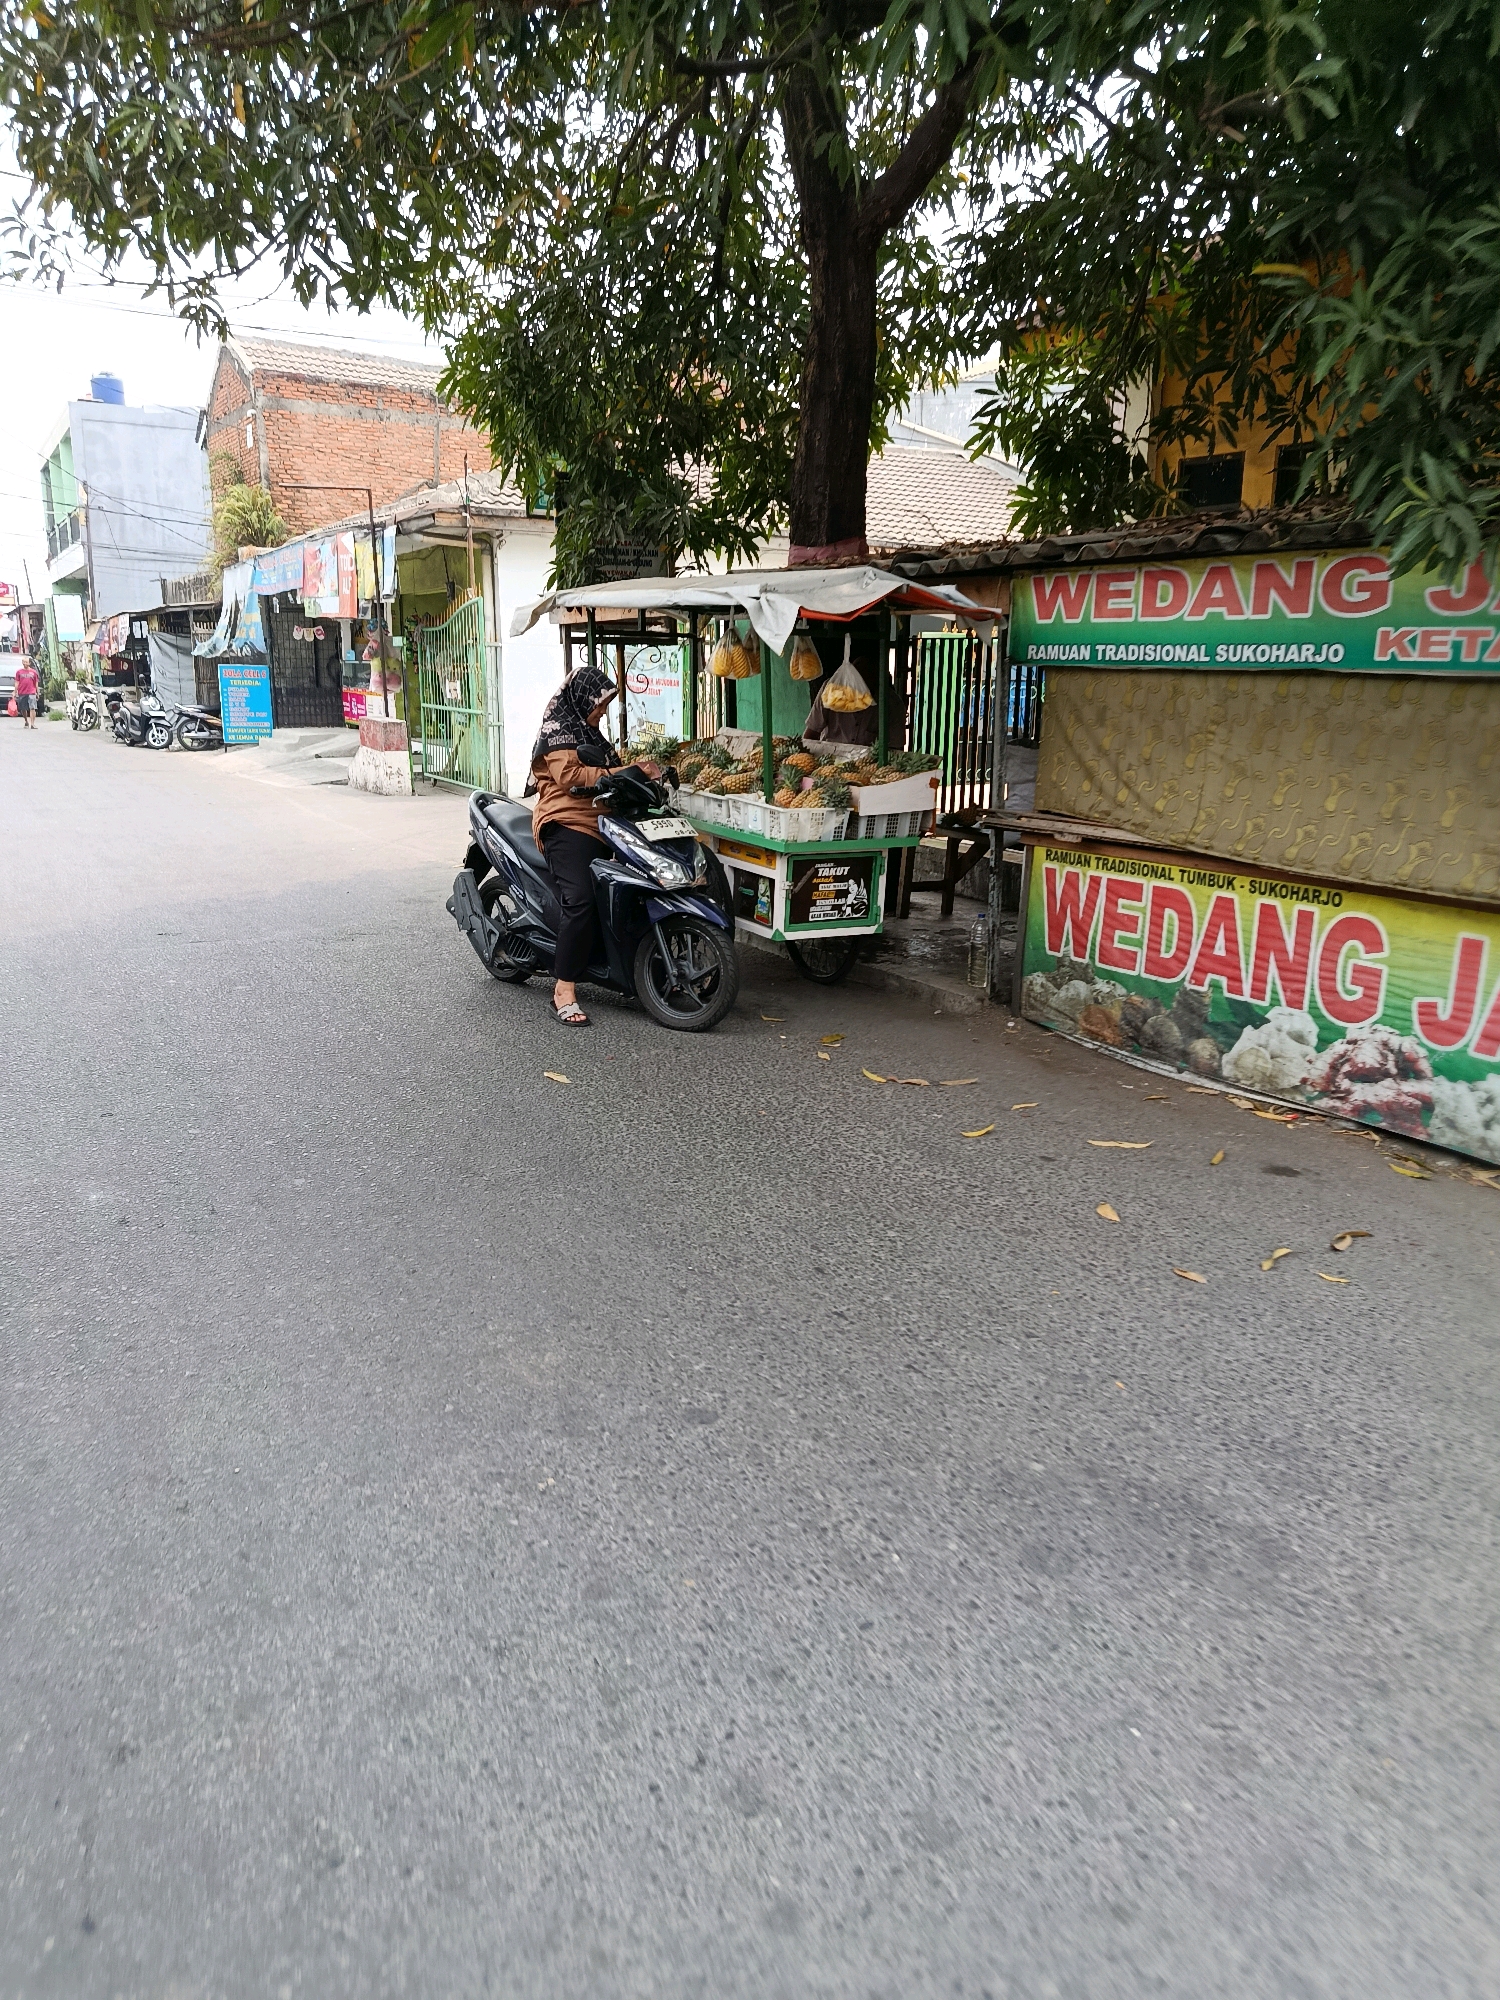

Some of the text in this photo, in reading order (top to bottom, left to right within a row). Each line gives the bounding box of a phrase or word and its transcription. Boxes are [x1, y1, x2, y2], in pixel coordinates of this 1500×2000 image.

[1031, 550, 1500, 623] WEDANG J
[1027, 644, 1091, 661] RAMUAN
[1095, 644, 1211, 662] TRADISIONAL
[1215, 643, 1345, 663] SUKOHARJO
[638, 823, 648, 831] Z
[650, 820, 674, 830] 5990
[625, 862, 649, 879] HONDA
[817, 866, 850, 877] TAKUT
[1045, 849, 1091, 868] RAMUAN
[1095, 857, 1175, 882] TRADISIONAL
[1179, 868, 1236, 891] TUMBUK
[1248, 880, 1343, 908] SUKOHARJO
[1043, 864, 1500, 1062] WEDANG J
